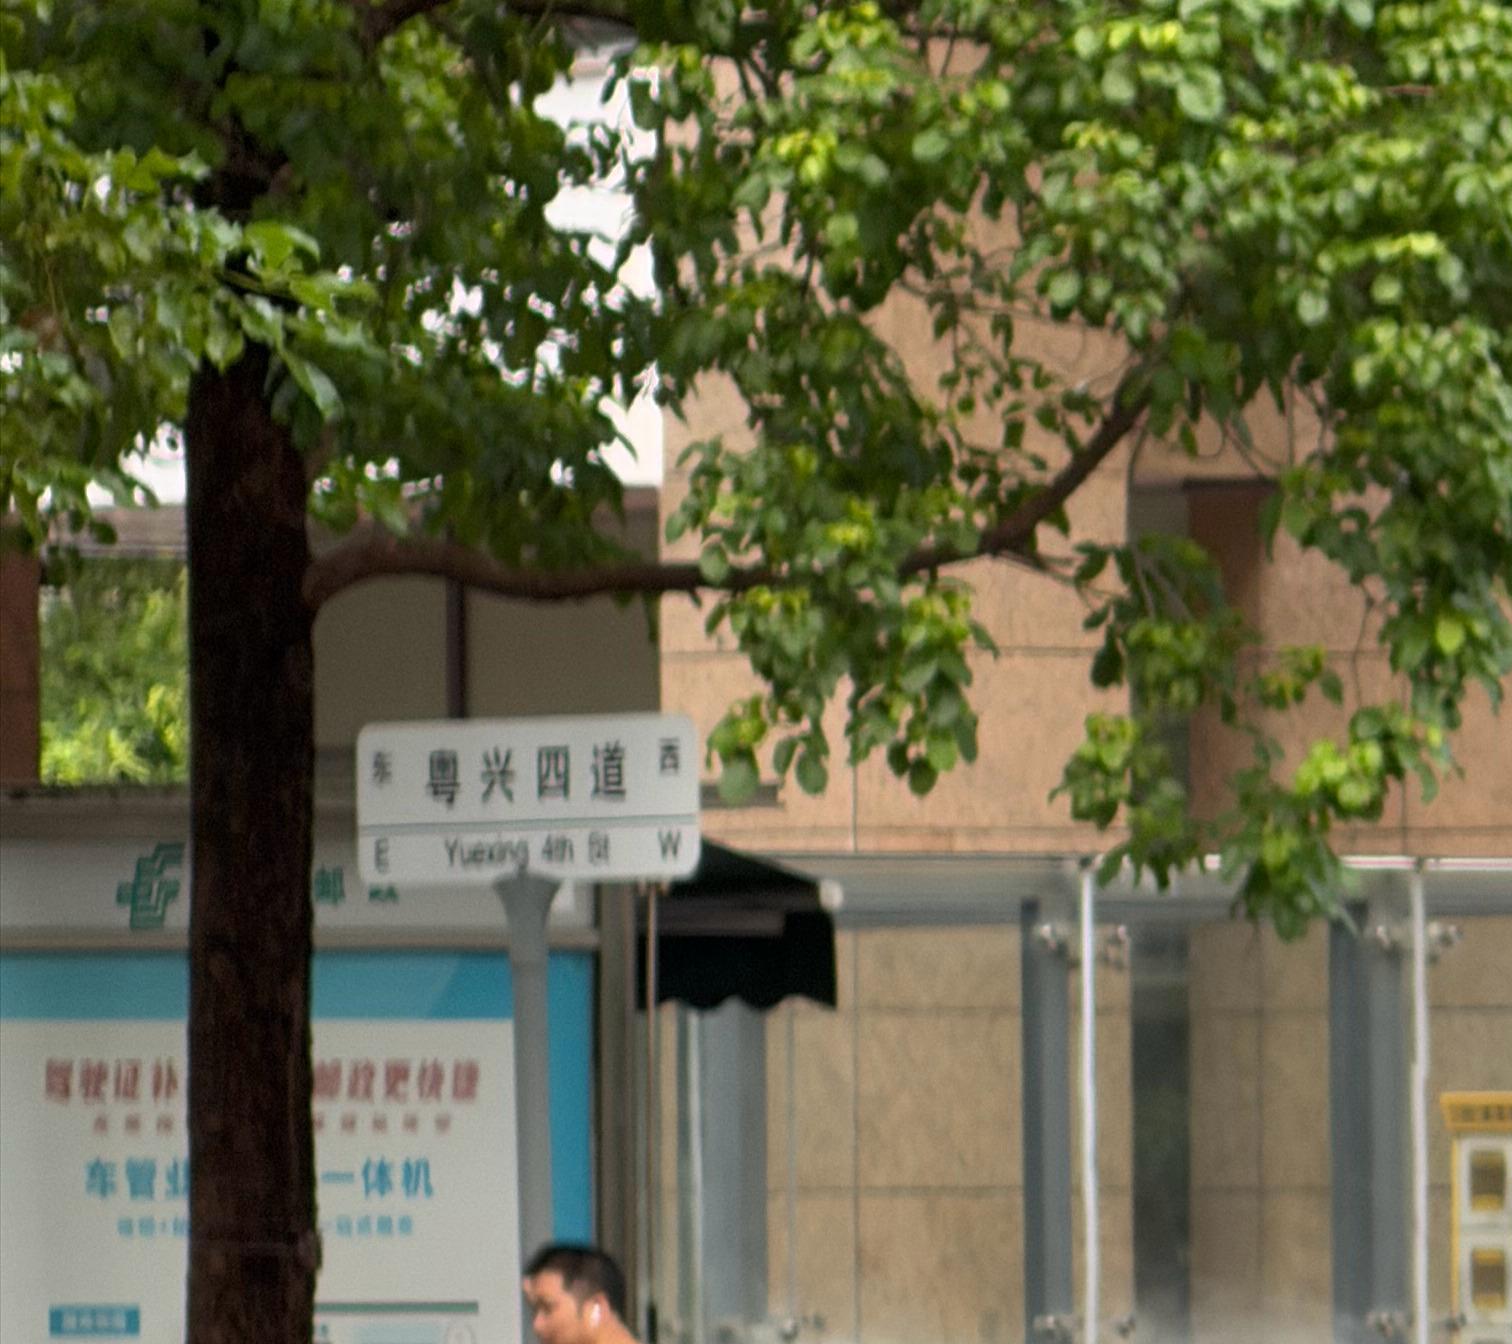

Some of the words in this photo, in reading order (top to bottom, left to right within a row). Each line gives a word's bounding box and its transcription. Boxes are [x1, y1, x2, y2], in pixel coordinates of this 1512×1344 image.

[373, 751, 392, 784] 东
[427, 740, 627, 811] 粤兴四道
[659, 738, 680, 774] 西
[374, 838, 389, 872] E
[444, 836, 530, 870] Yuexing
[541, 833, 575, 863] 4th
[658, 829, 681, 861] W
